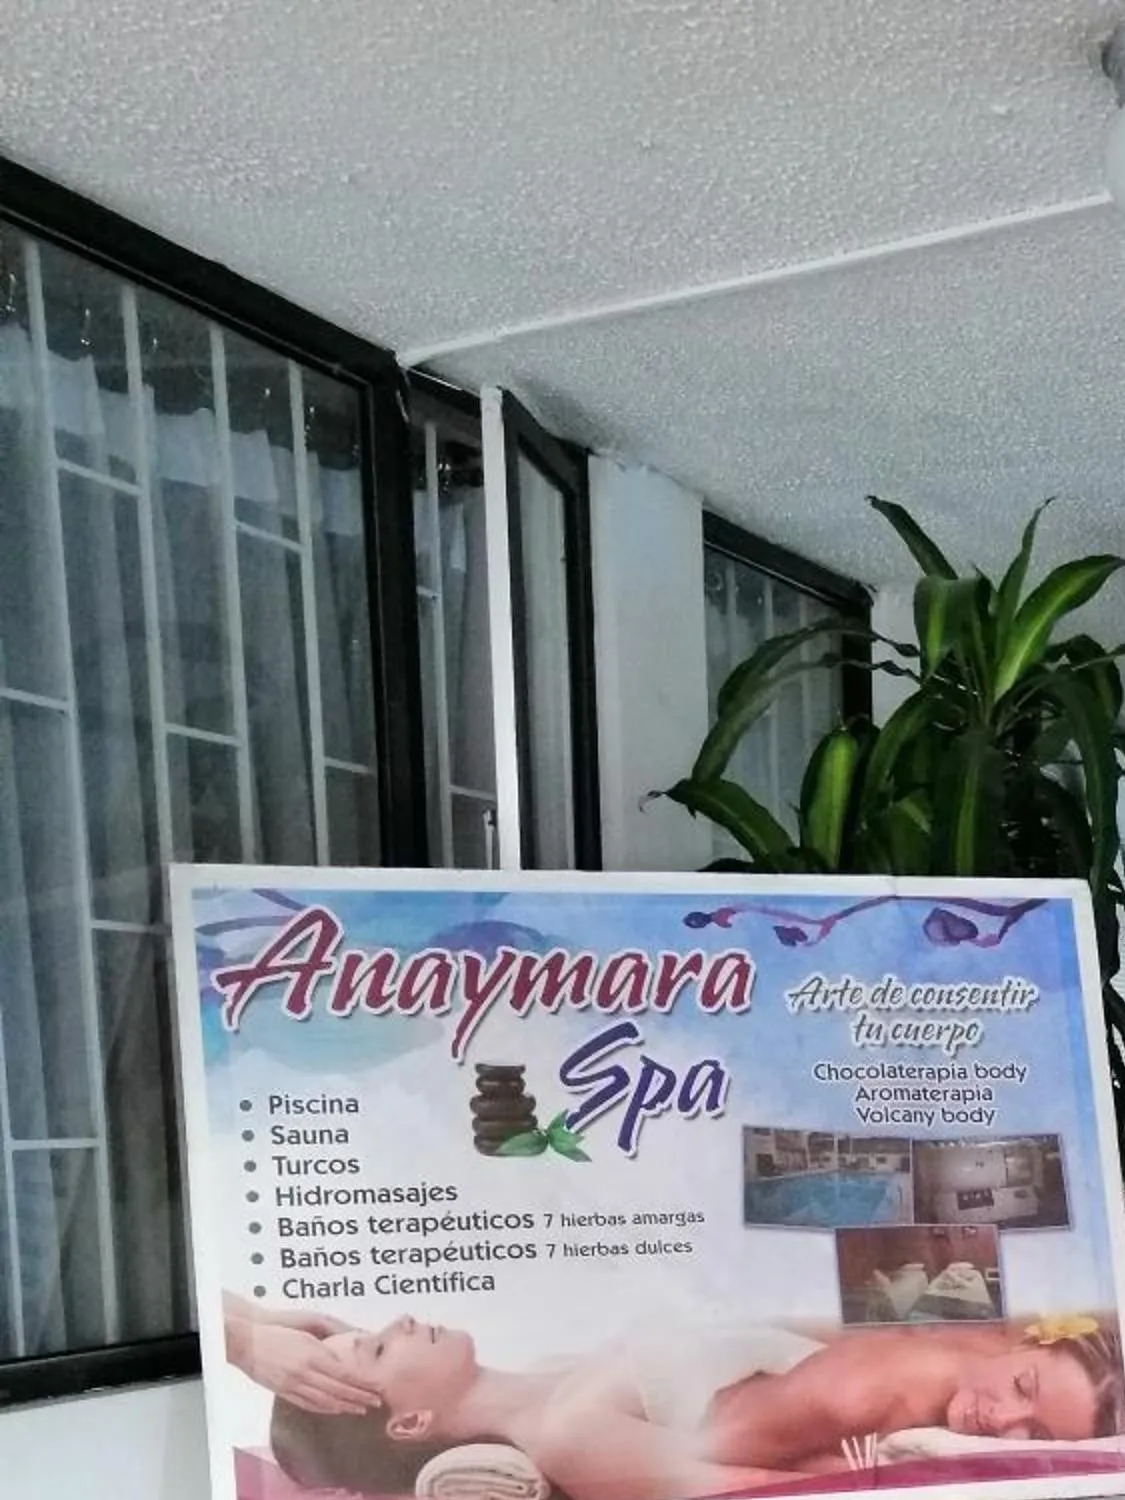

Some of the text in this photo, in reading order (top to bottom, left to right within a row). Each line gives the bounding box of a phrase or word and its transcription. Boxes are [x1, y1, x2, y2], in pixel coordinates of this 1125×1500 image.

[213, 906, 754, 1060] Anaymara
[788, 975, 1038, 1009] Arte de consentir
[853, 1013, 980, 1053] tu cuerpo
[813, 1062, 1027, 1083] Chocolaterapia body
[558, 1020, 727, 1154] Spa
[855, 1084, 993, 1104] Aromaterapia
[268, 1094, 360, 1115] Piscina
[856, 1106, 996, 1127] Volcany body
[270, 1125, 349, 1145] Sauna
[271, 1155, 360, 1176] Turcos
[275, 1181, 459, 1207] Hidromasajes
[277, 1209, 706, 1238] Baños terapéuticos 7 hierbas amargas
[280, 1239, 693, 1269] Baños terapéuticos 7 hierbas dulces
[282, 1270, 496, 1299] Charla Científica
